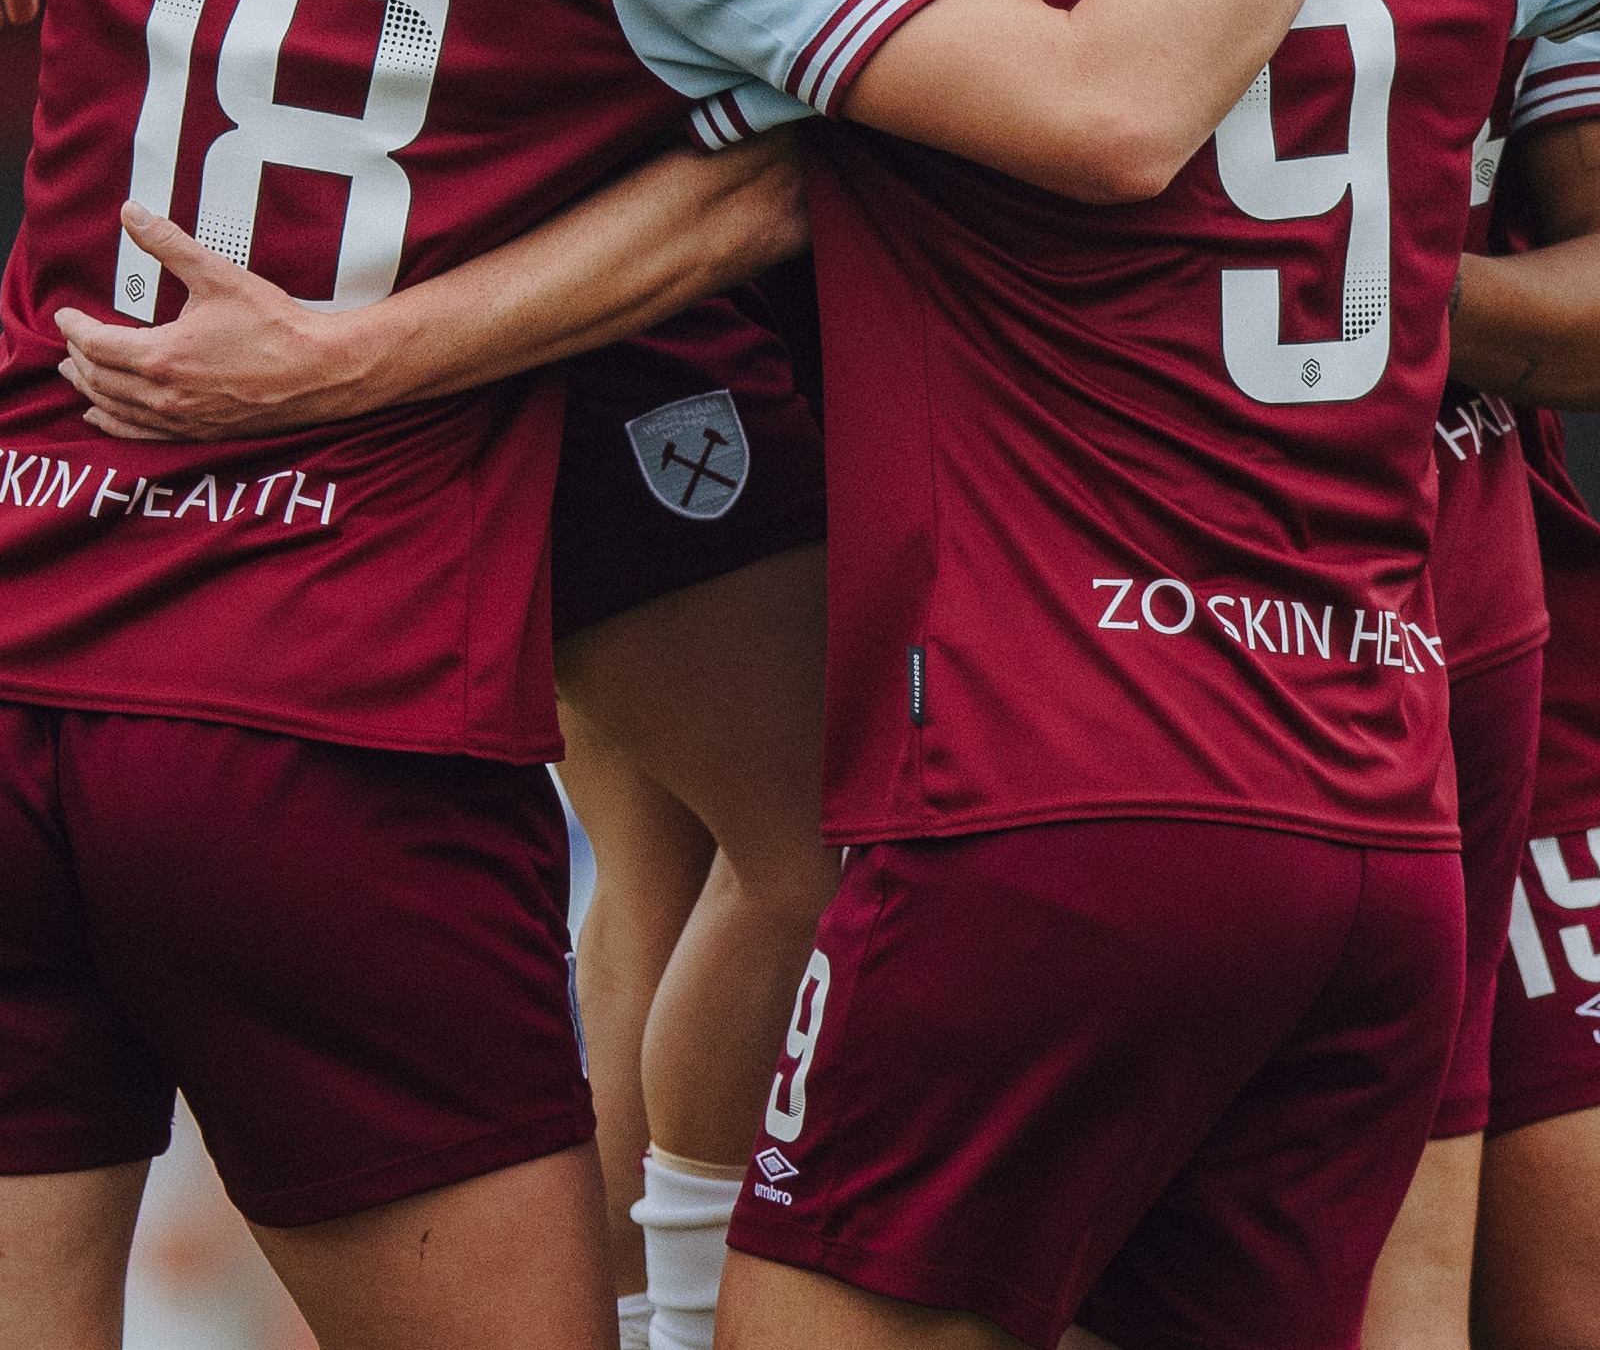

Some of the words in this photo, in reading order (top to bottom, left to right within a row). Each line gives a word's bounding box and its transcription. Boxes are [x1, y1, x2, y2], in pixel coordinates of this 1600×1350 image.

[1092, 577, 1196, 635] ZO
[1206, 594, 1333, 660] SKIN
[765, 948, 831, 1142] 9
[754, 1182, 793, 1206] umbro
